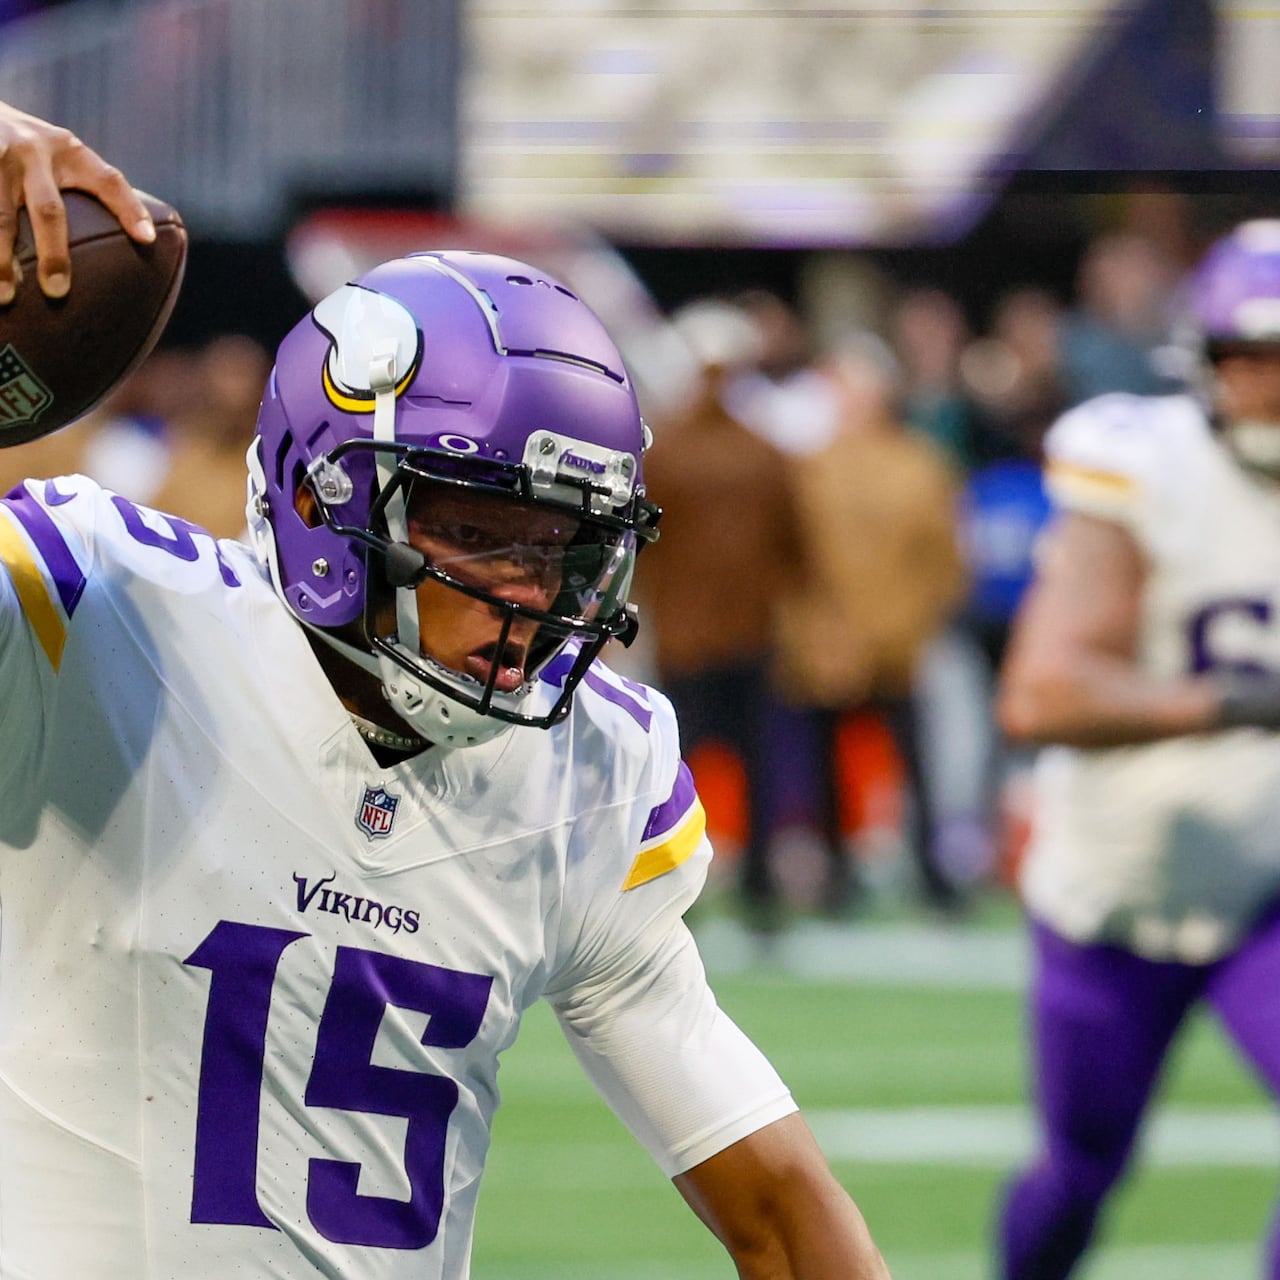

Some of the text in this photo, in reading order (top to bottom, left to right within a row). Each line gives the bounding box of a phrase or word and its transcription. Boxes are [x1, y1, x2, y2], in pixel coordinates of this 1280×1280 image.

[361, 804, 391, 832] NFL
[293, 869, 421, 935] VIKINGS
[182, 919, 495, 1250] 15
